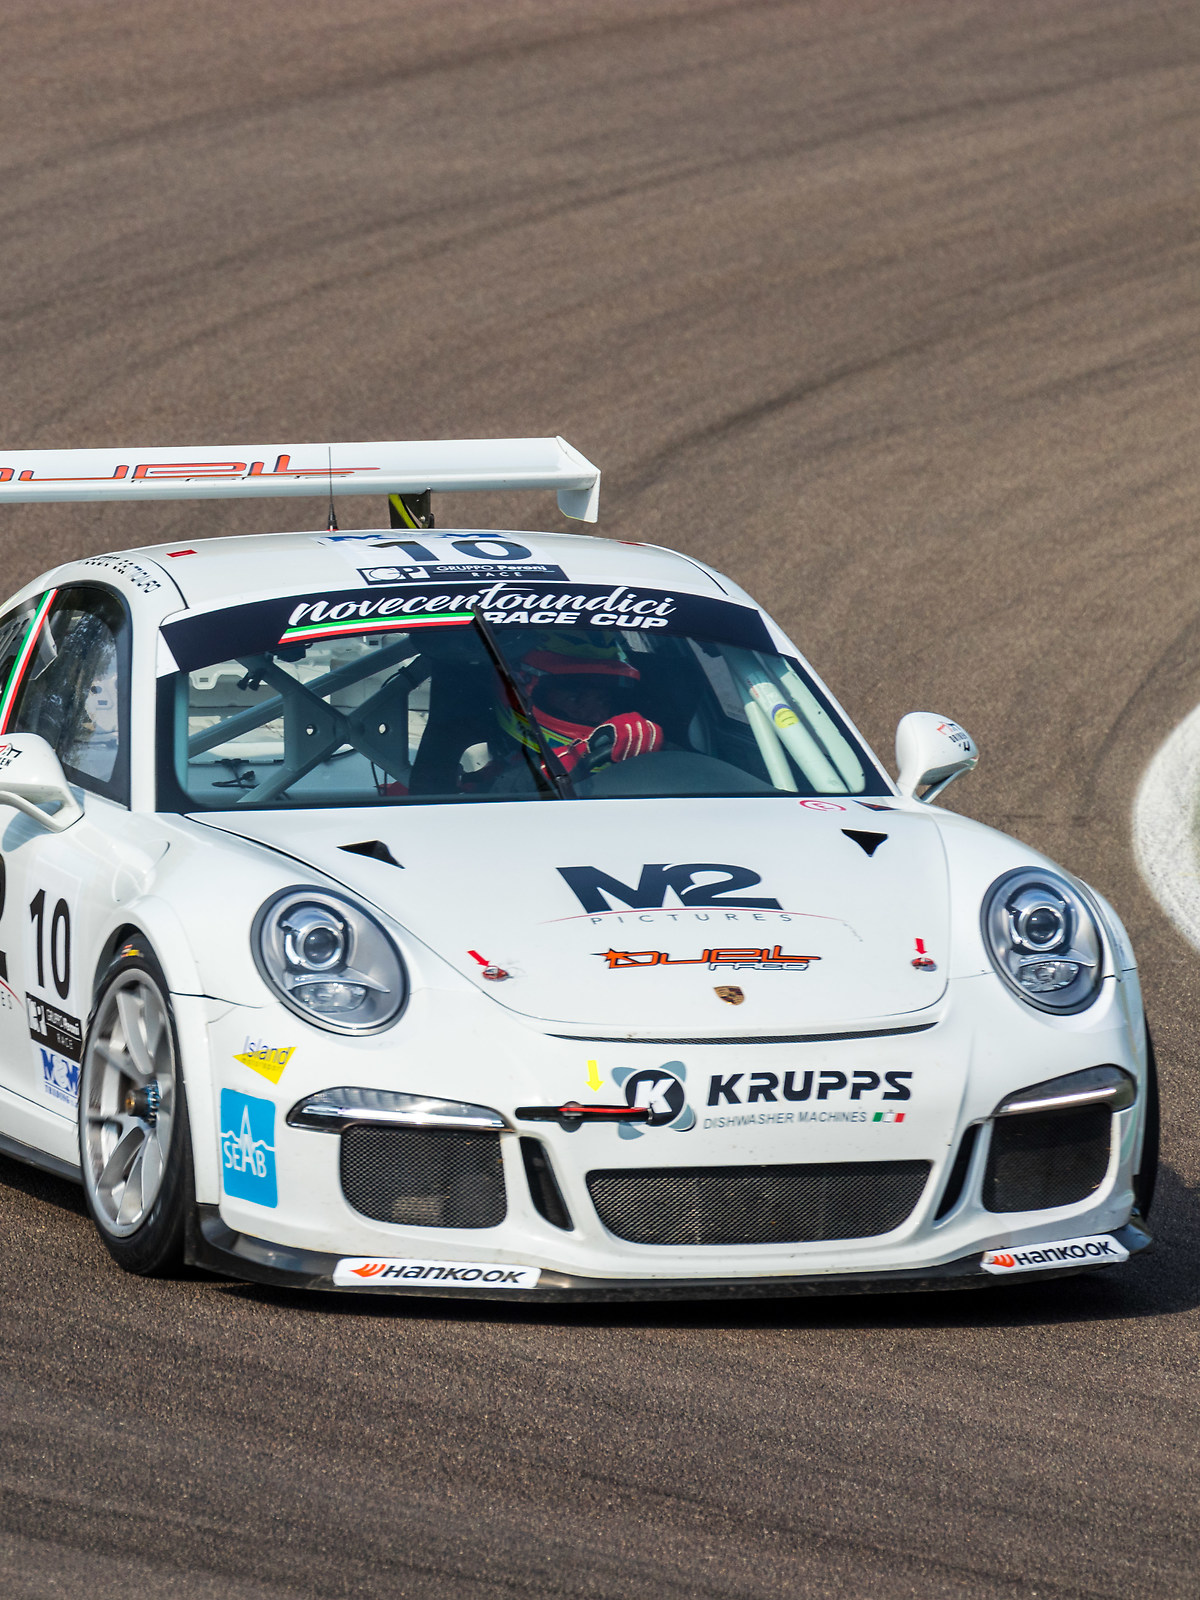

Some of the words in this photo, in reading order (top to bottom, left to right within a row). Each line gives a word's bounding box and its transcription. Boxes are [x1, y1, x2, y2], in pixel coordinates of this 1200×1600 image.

[367, 540, 533, 562] 10
[288, 583, 677, 626] novecentoundici
[483, 611, 577, 625] RACE
[590, 614, 669, 629] CUP
[556, 862, 784, 914] M2
[590, 913, 792, 925] PICTURES
[29, 888, 71, 1001] 10
[243, 1035, 292, 1066] Island
[706, 1071, 913, 1106] KRUPPS
[704, 1112, 794, 1129] DISHWASHER
[798, 1110, 867, 1124] MACHINES
[223, 1104, 267, 1178] SEAB
